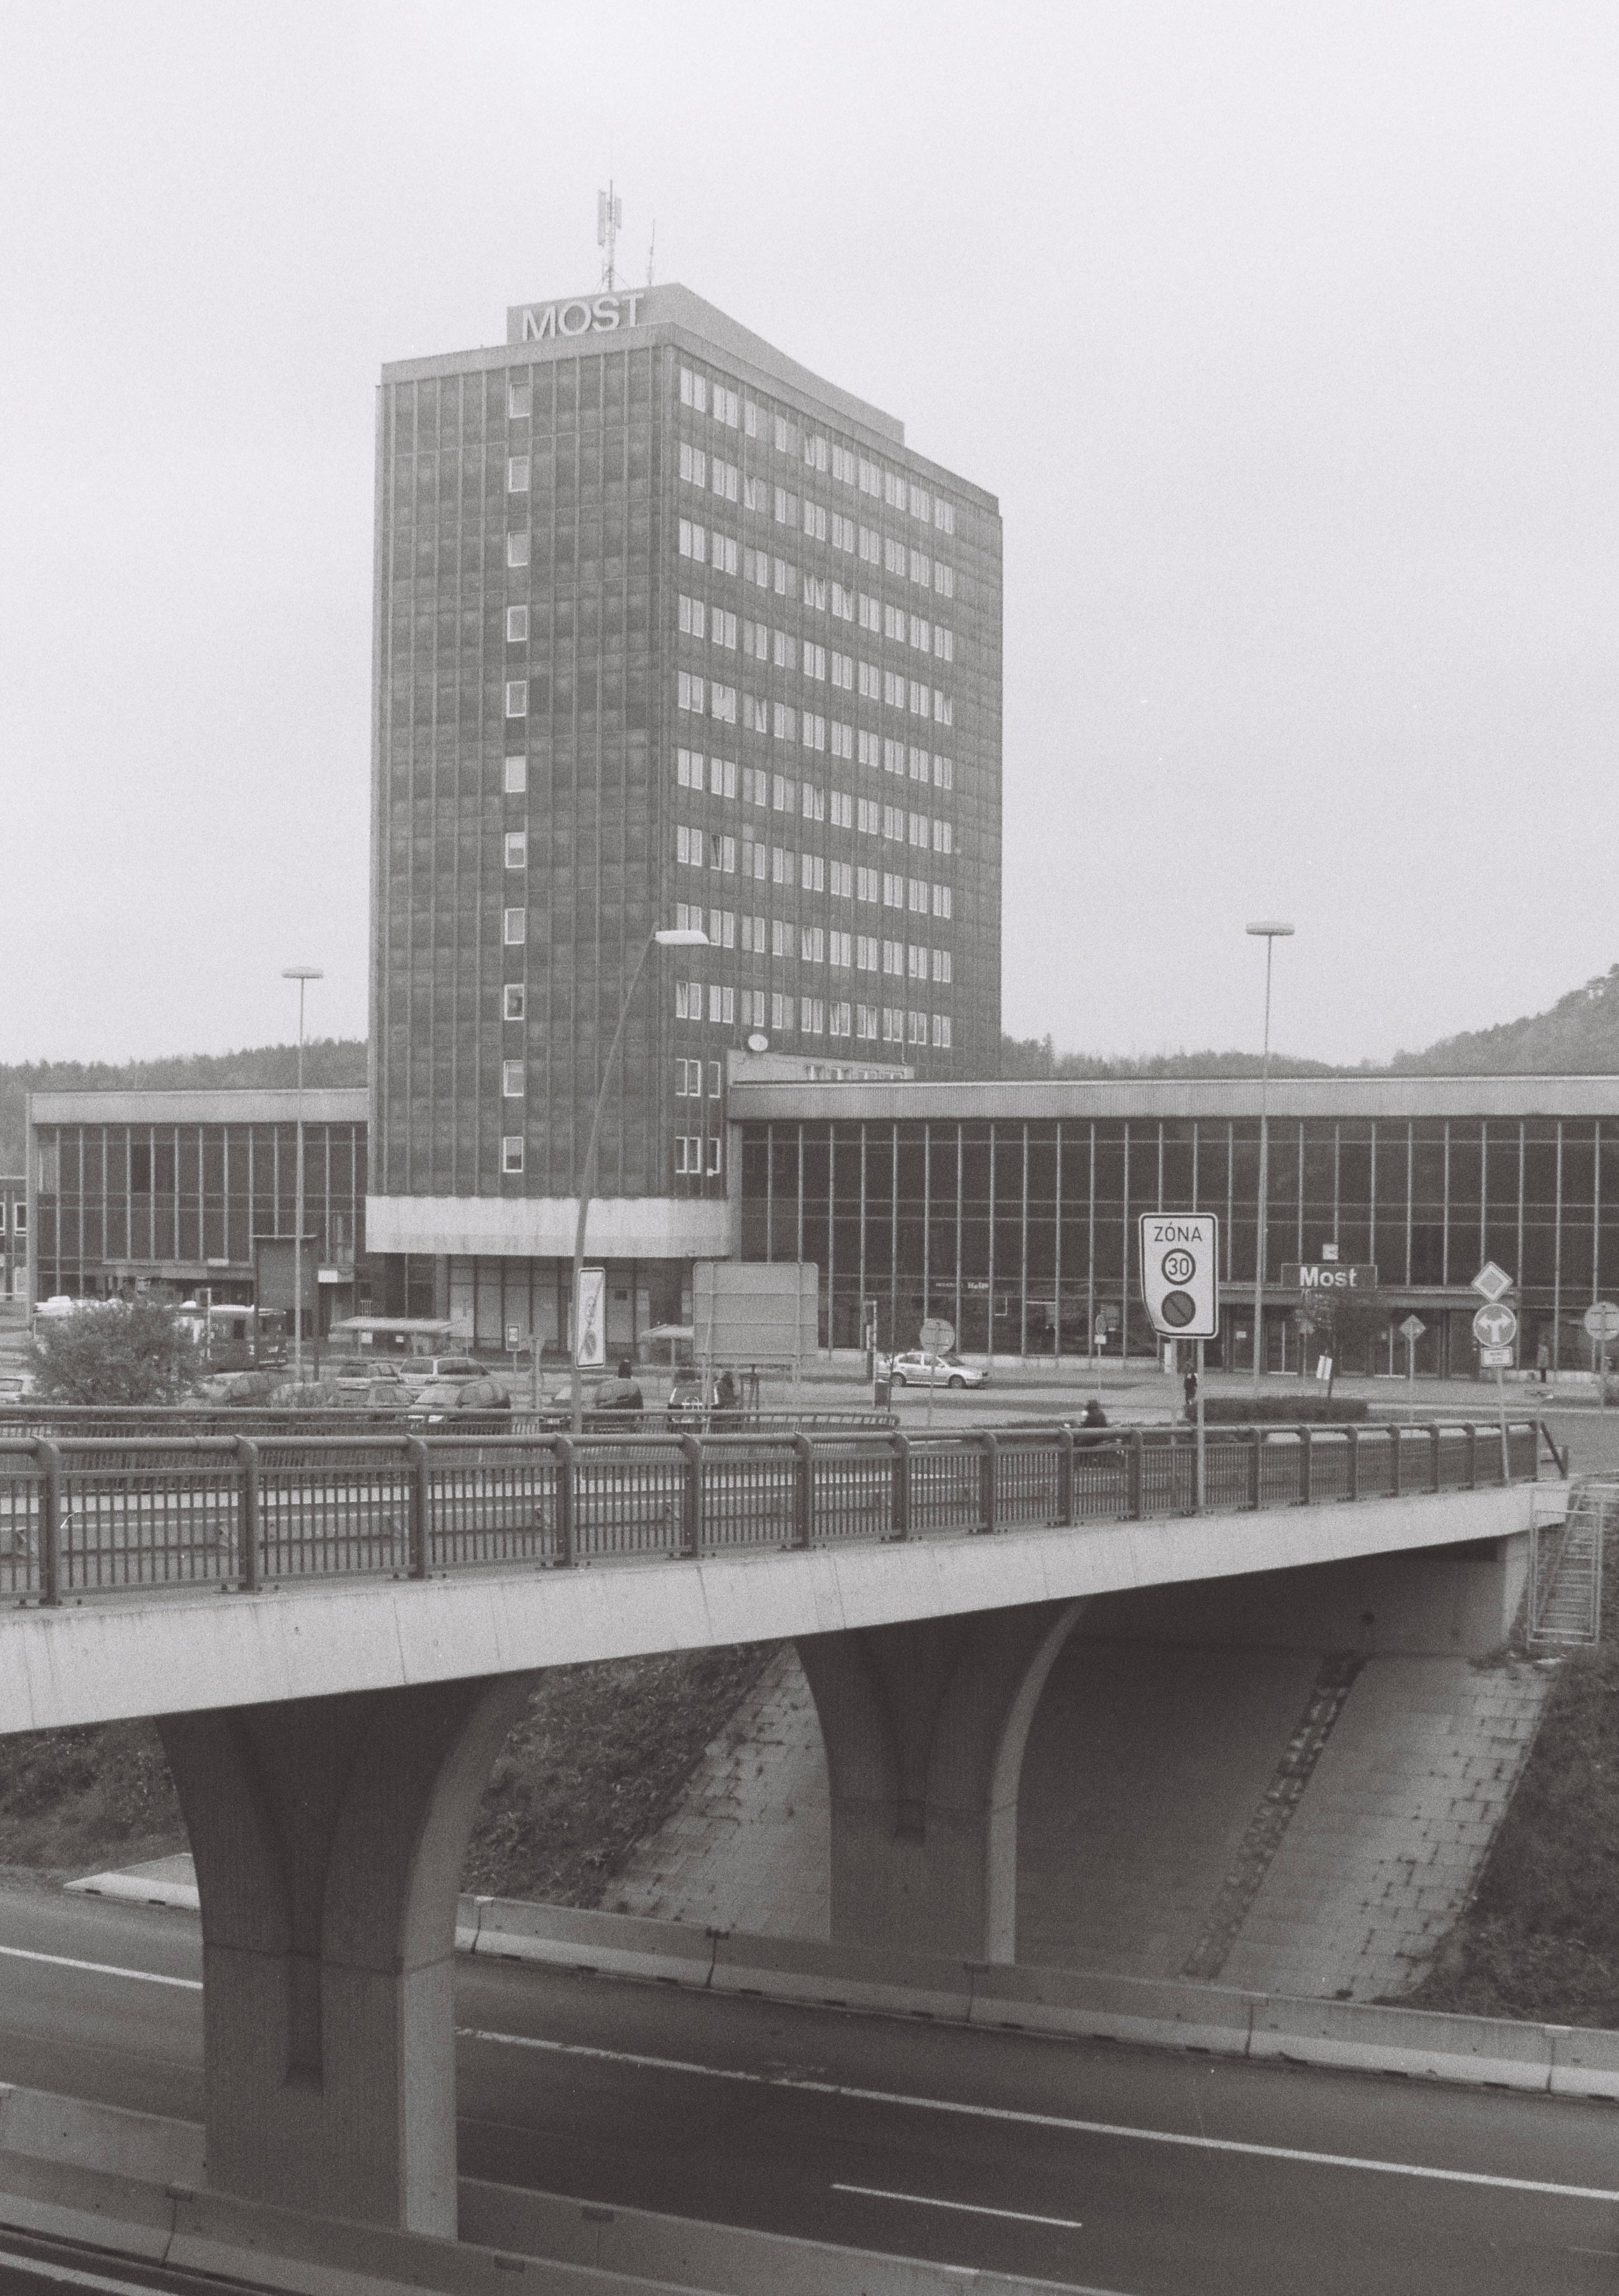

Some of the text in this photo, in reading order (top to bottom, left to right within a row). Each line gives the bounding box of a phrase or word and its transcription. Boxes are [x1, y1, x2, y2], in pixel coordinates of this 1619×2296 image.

[522, 292, 644, 341] MOST
[1154, 1222, 1202, 1242] ZÓNA
[1167, 1258, 1190, 1276] 30
[1300, 1266, 1357, 1287] Most
